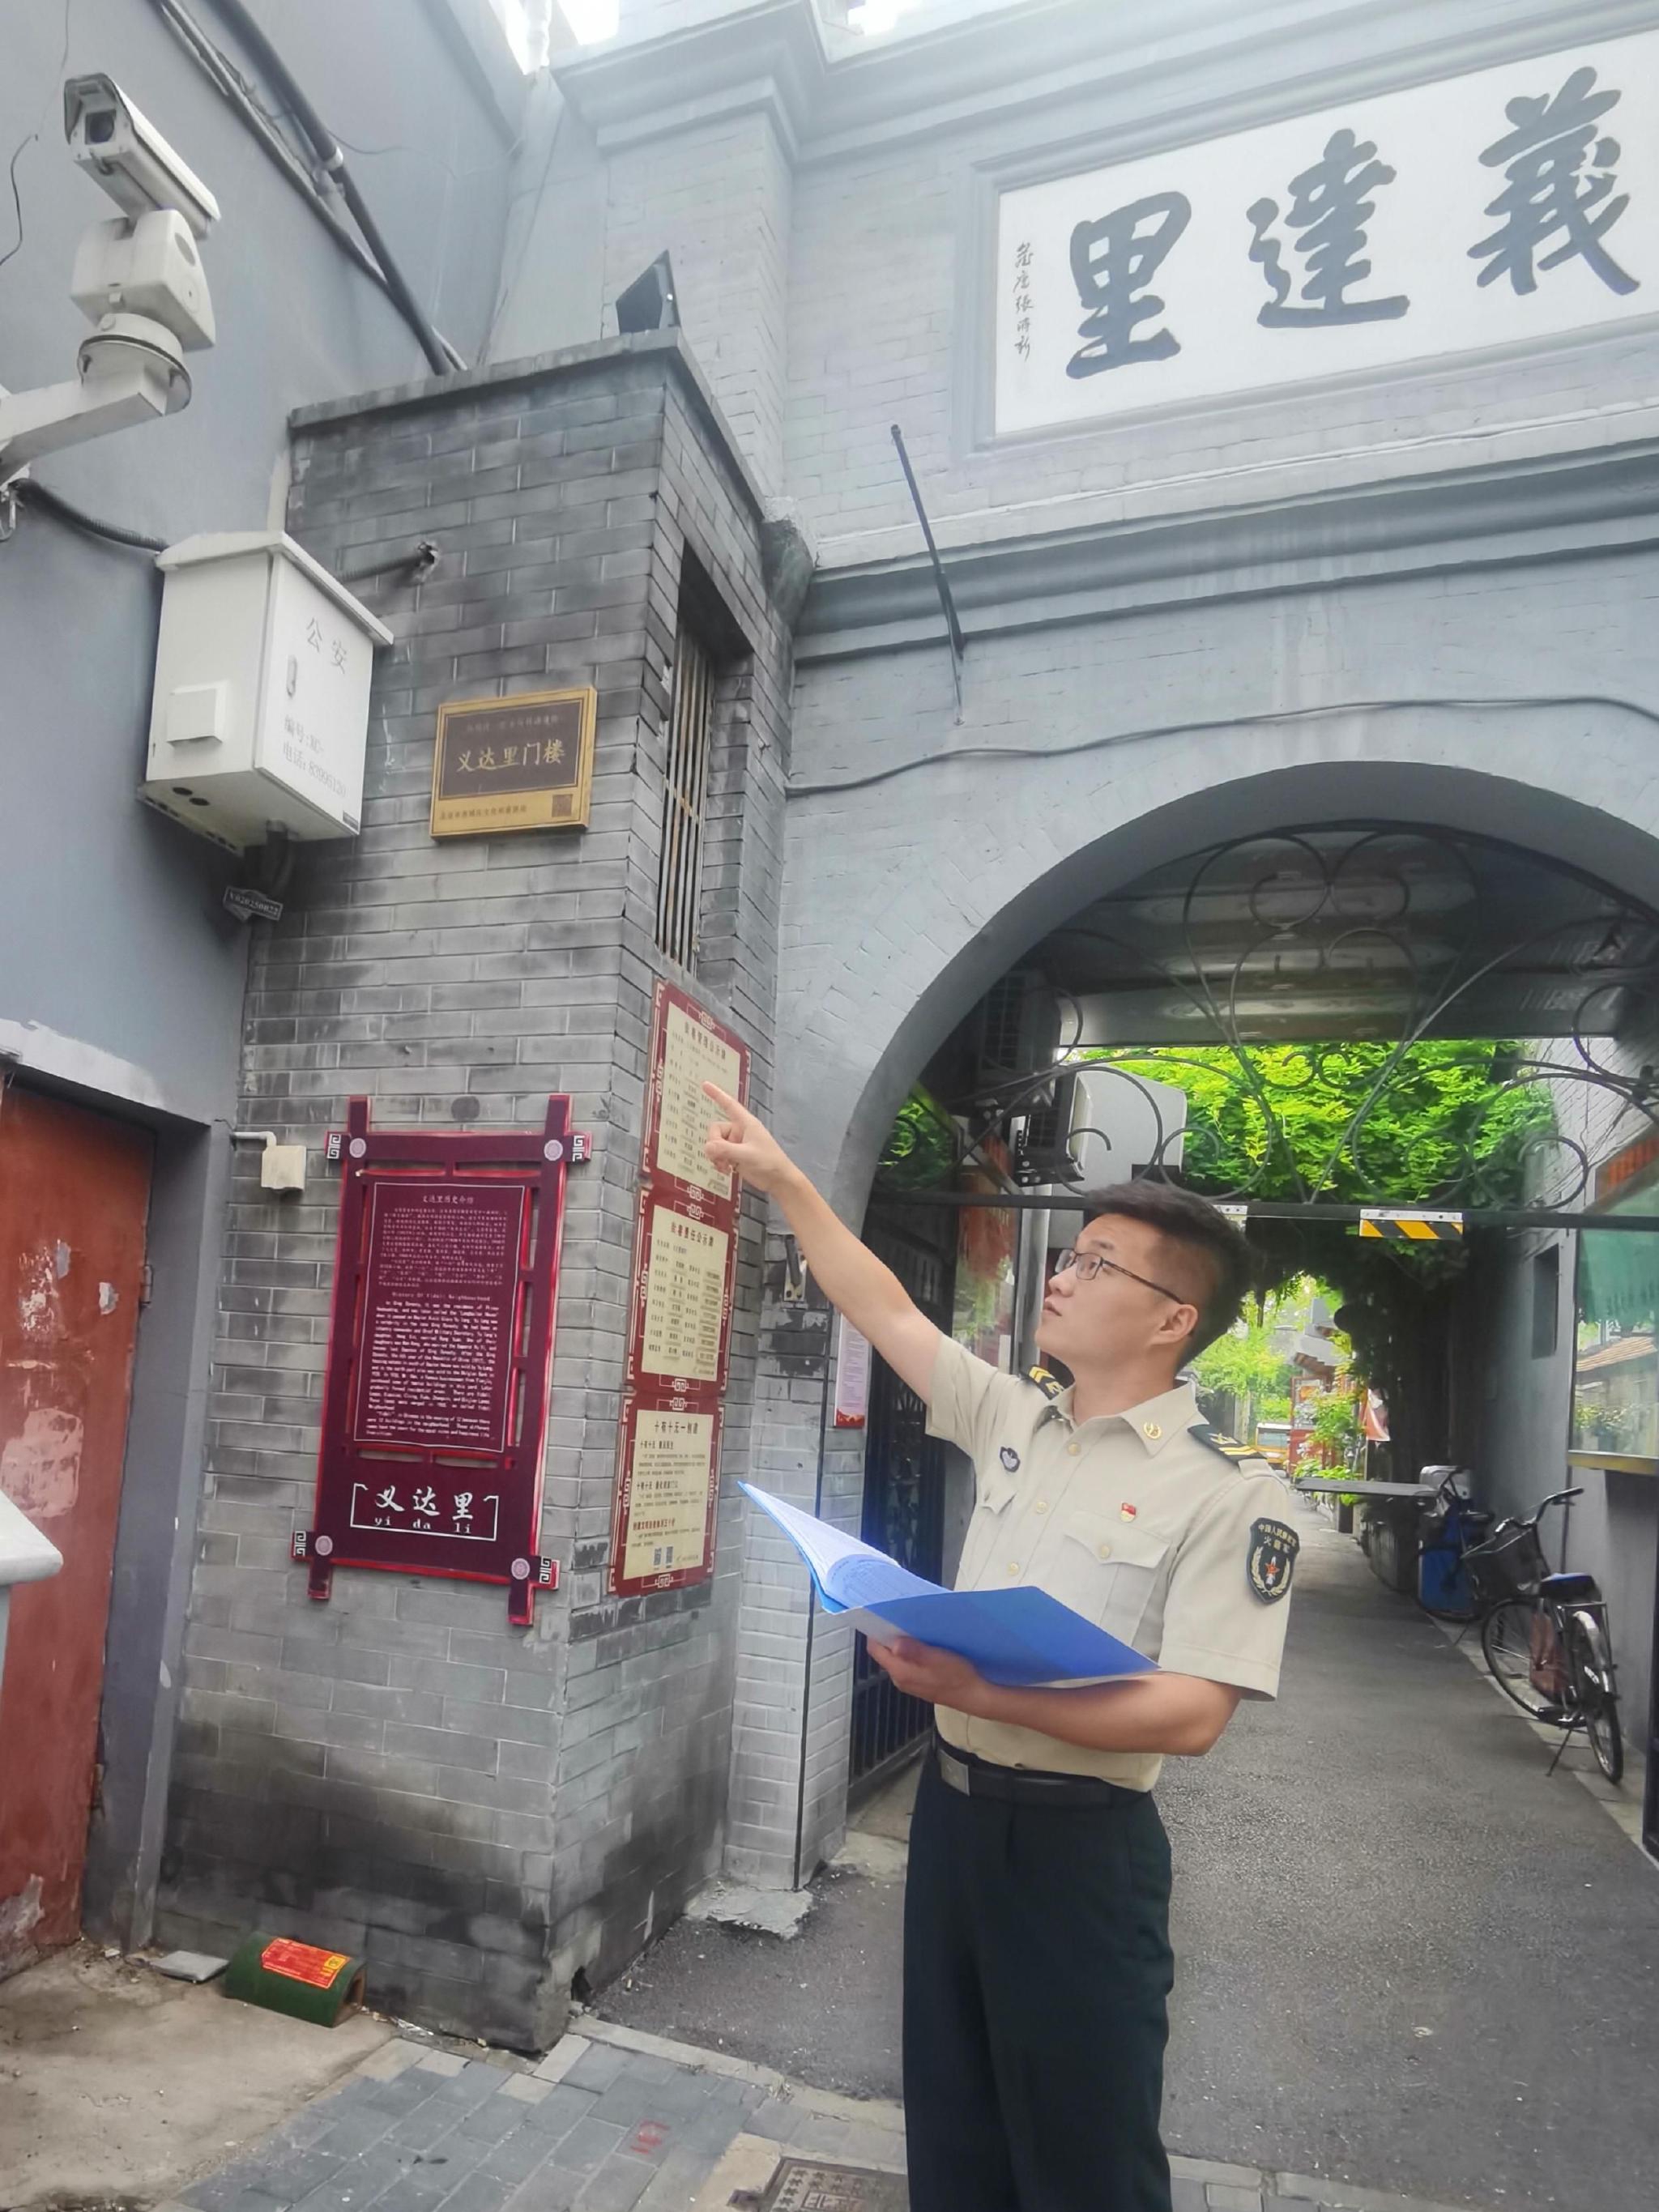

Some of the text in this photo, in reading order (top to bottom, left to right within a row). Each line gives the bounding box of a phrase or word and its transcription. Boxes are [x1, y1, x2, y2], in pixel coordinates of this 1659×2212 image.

[456, 739, 565, 774] 义达里门楼
[374, 1485, 474, 1520] 义达里
[374, 1515, 471, 1533] yi da li
